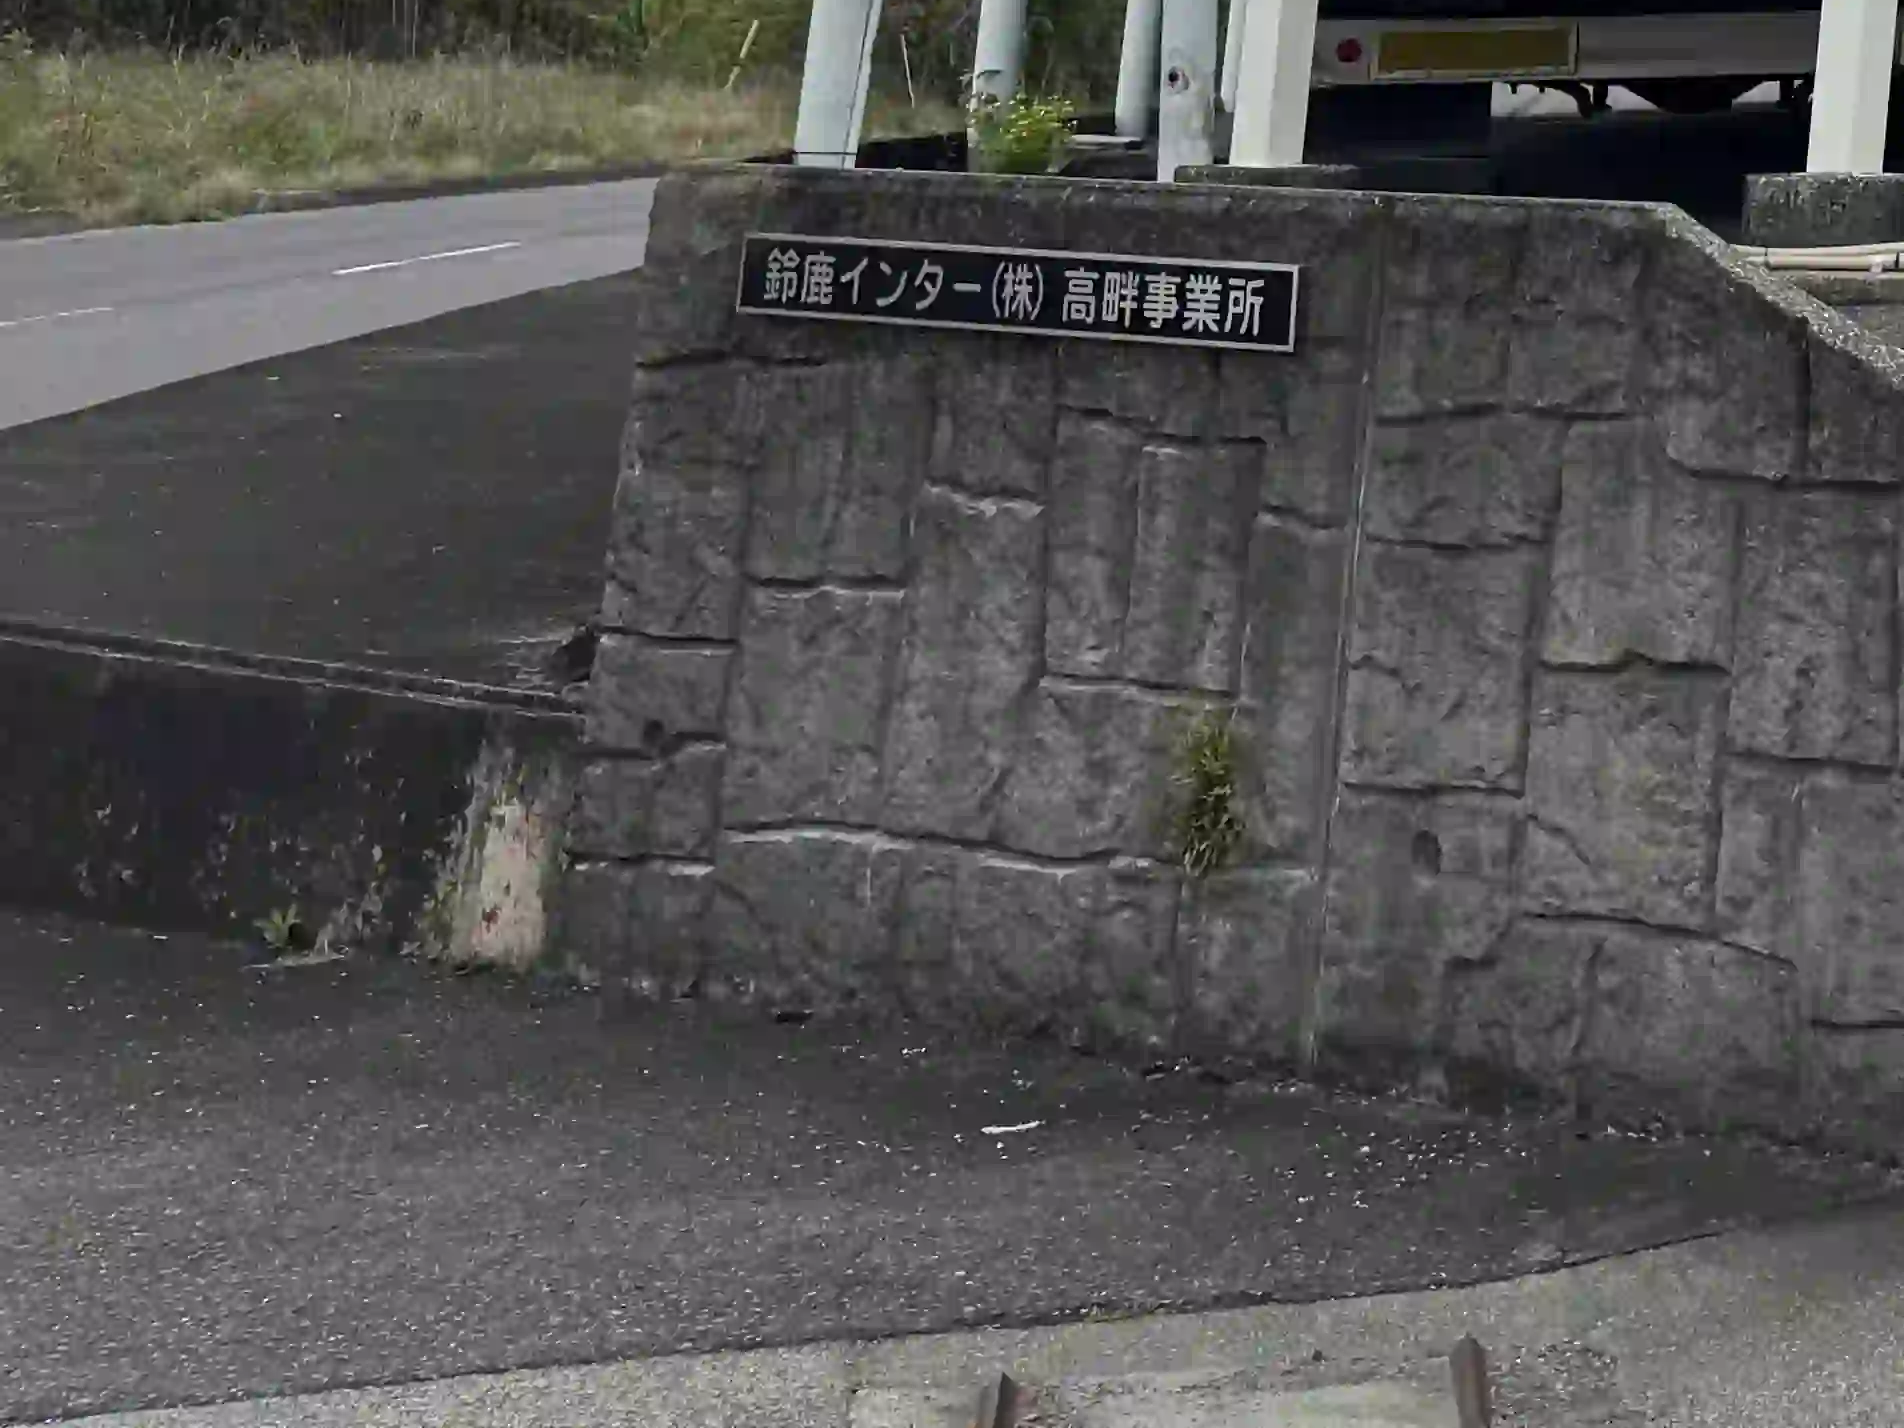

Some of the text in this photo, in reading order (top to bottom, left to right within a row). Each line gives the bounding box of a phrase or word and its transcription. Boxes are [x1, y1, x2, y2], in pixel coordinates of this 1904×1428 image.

[1062, 267, 1266, 337] 高畔事業所
